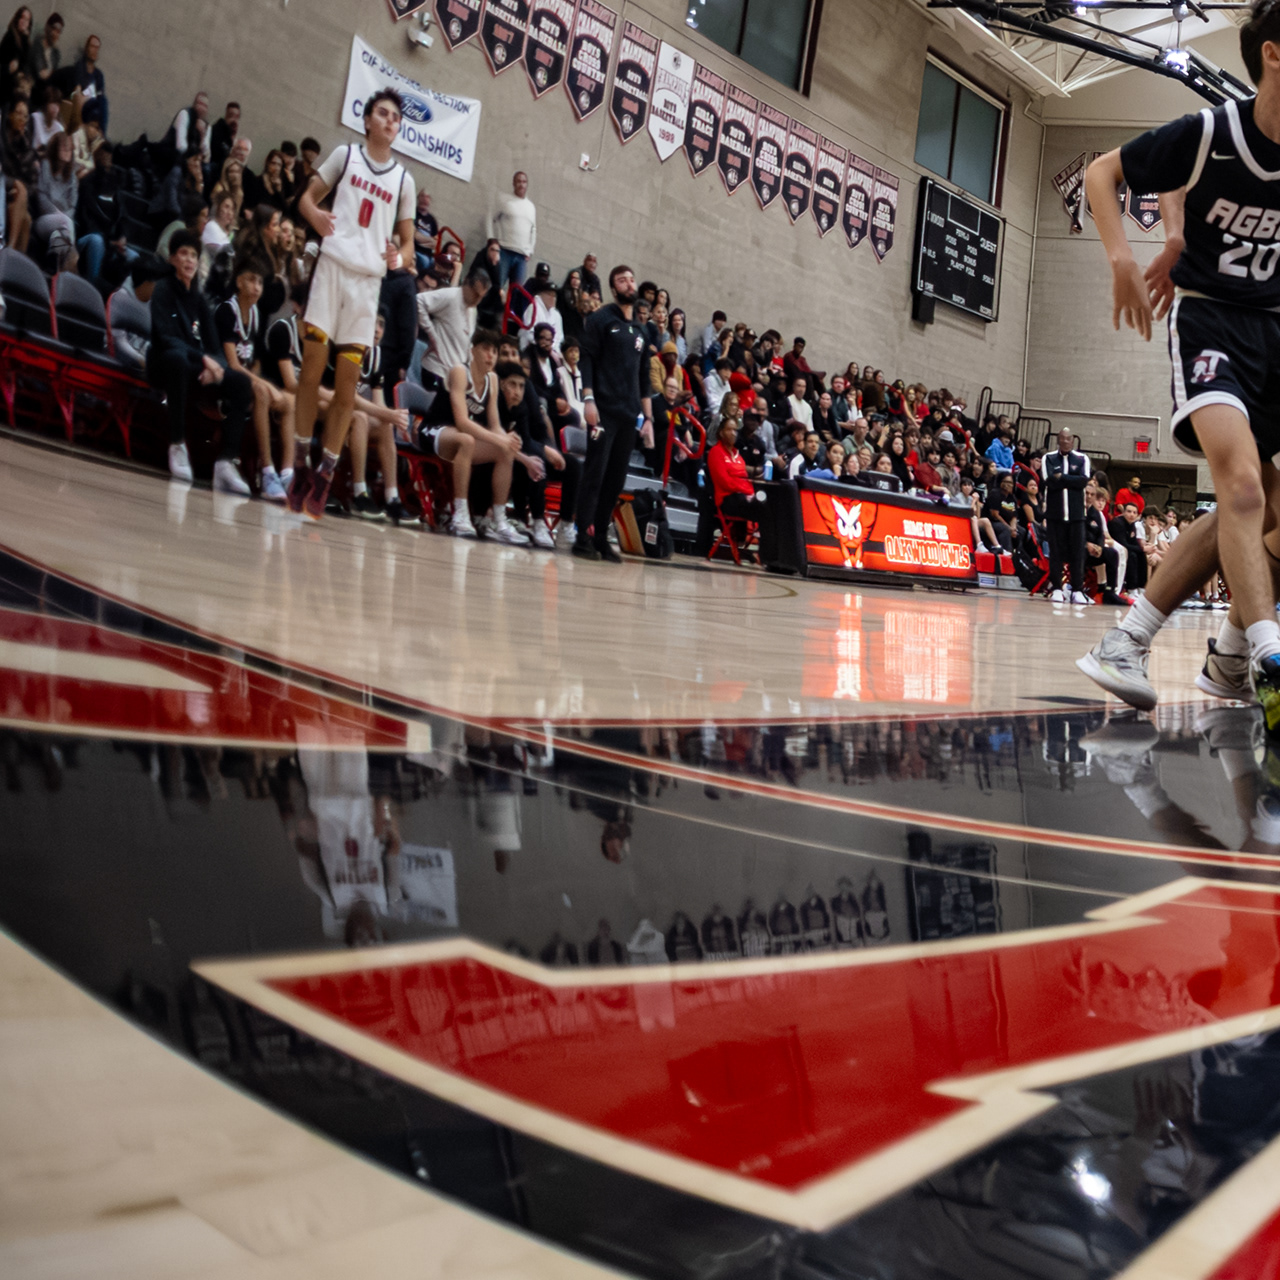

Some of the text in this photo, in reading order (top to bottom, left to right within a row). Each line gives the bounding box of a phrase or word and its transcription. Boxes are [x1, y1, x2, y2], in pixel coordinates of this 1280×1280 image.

[362, 51, 379, 67] CIF
[403, 98, 424, 122] Ford
[353, 100, 463, 165] CIONSHIPS
[358, 198, 374, 229] 0
[903, 520, 948, 540] HOME OF THE
[885, 535, 971, 569] OAKWOOD OWLS
